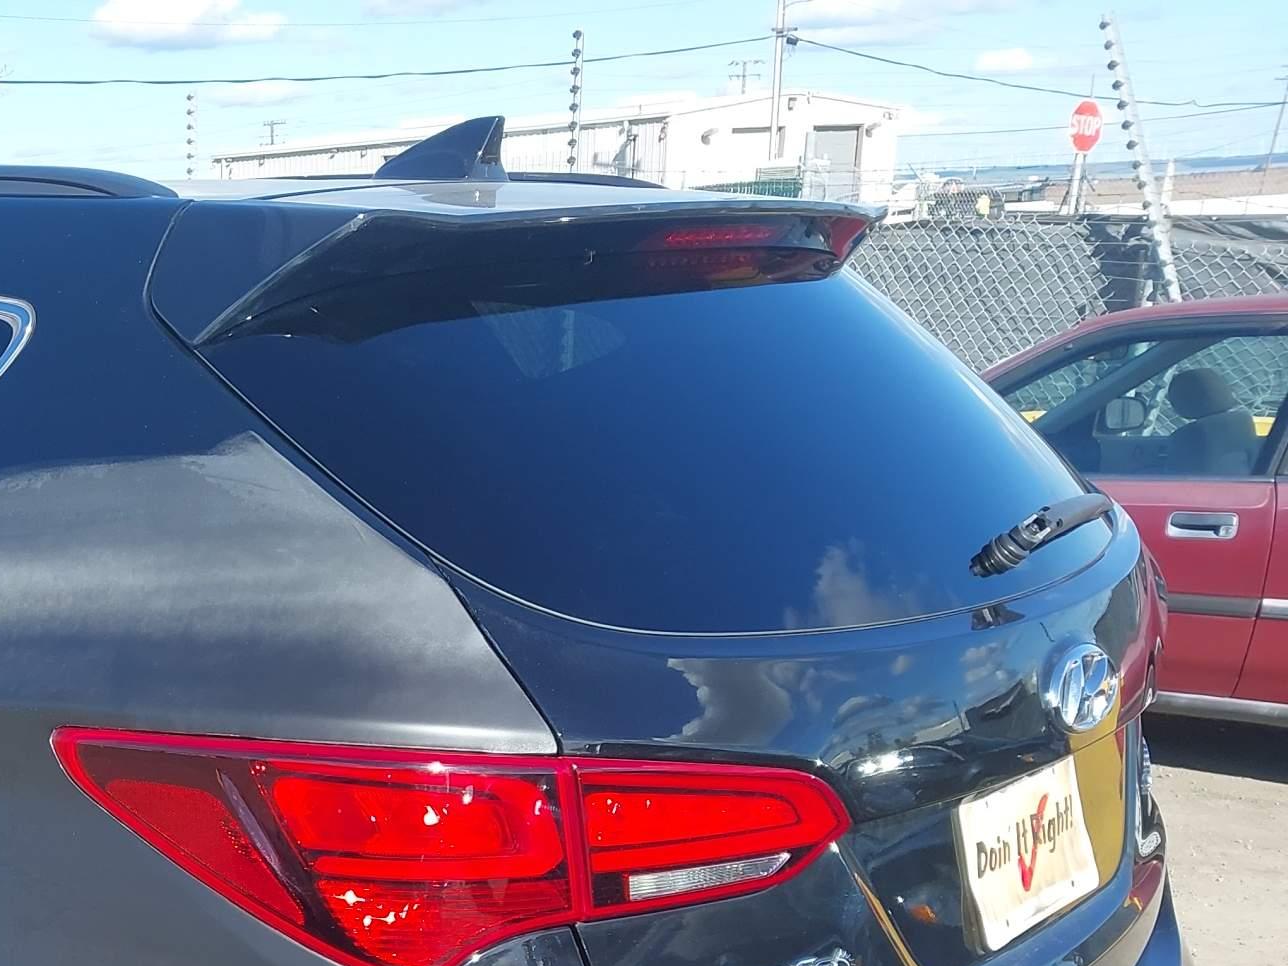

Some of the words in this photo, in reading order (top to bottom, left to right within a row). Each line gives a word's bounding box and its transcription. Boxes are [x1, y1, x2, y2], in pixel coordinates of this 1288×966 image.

[1071, 114, 1101, 136] STOP
[976, 835, 1011, 879] Doin
[1015, 818, 1028, 857] It
[1030, 793, 1073, 853] Right!
